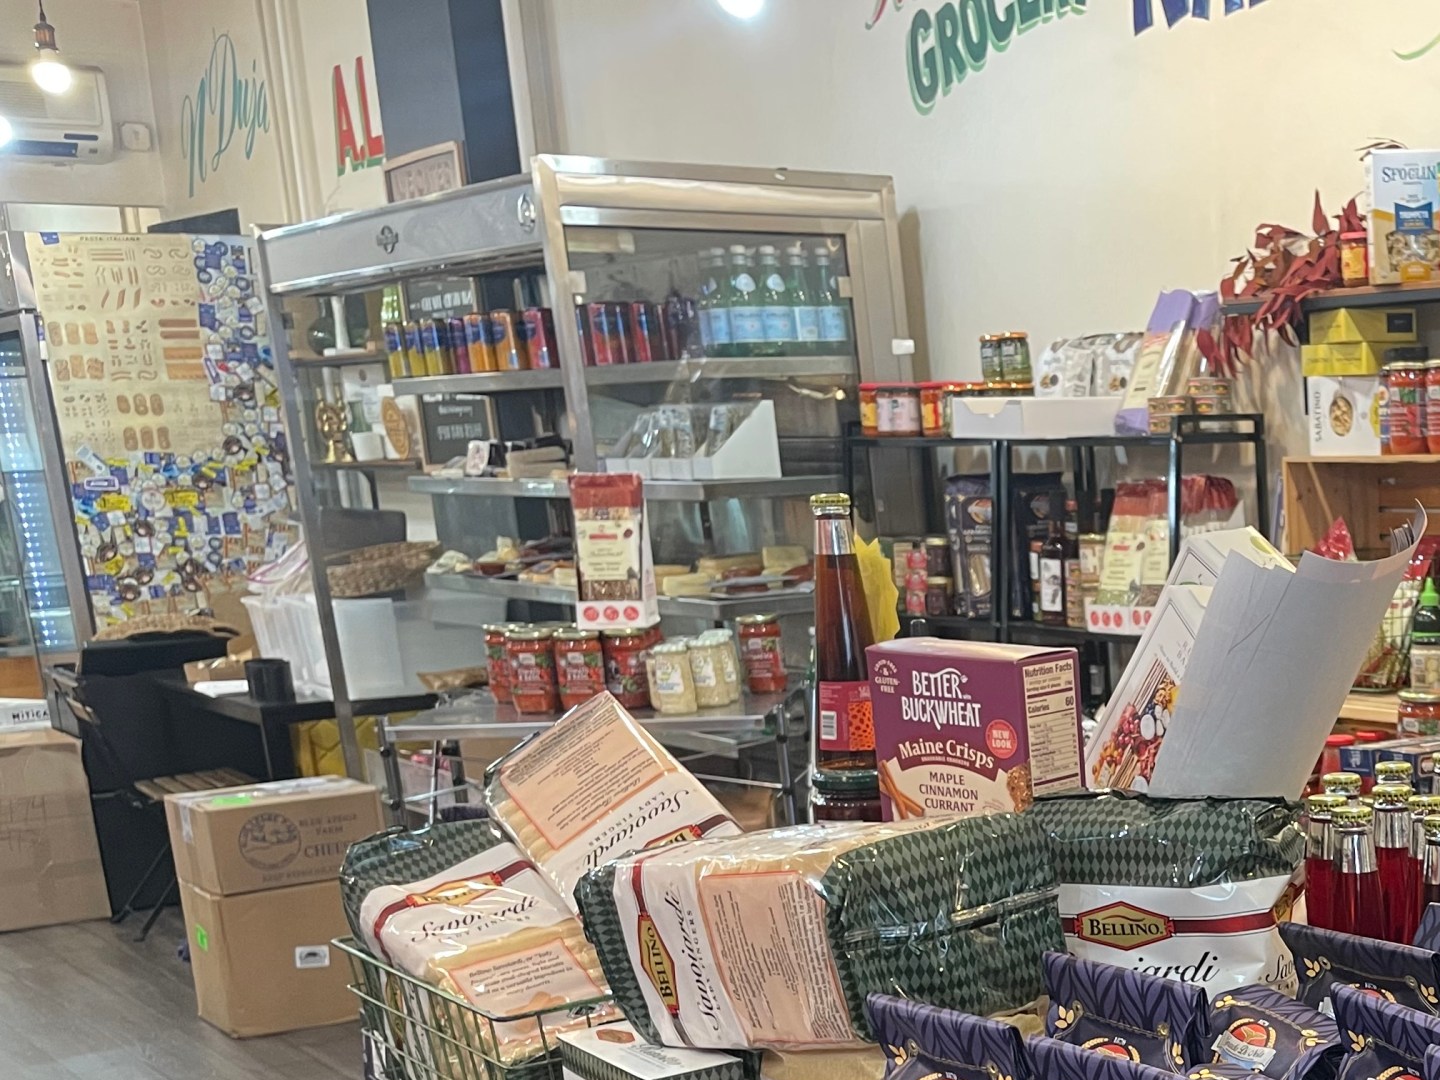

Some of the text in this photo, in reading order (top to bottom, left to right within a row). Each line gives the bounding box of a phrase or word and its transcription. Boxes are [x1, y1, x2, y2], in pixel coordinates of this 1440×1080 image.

[1382, 165, 1437, 183] SFOGLIN
[1024, 663, 1073, 678] Nutrition Facts
[912, 668, 961, 700] BETTER
[902, 696, 981, 730] BUCKWHEAT
[1028, 704, 1050, 714] Calories
[992, 729, 1010, 740] NEW
[991, 739, 1012, 749] LOOK
[899, 739, 995, 769] Maine Crisps
[929, 772, 965, 785] MAPLE
[637, 791, 666, 811] LADY
[919, 784, 979, 800] CINNAMON
[924, 798, 975, 812] CURRANT
[582, 788, 690, 875] Savoiardi
[648, 926, 673, 999] BELLINO
[664, 889, 720, 1032] Savoiardi
